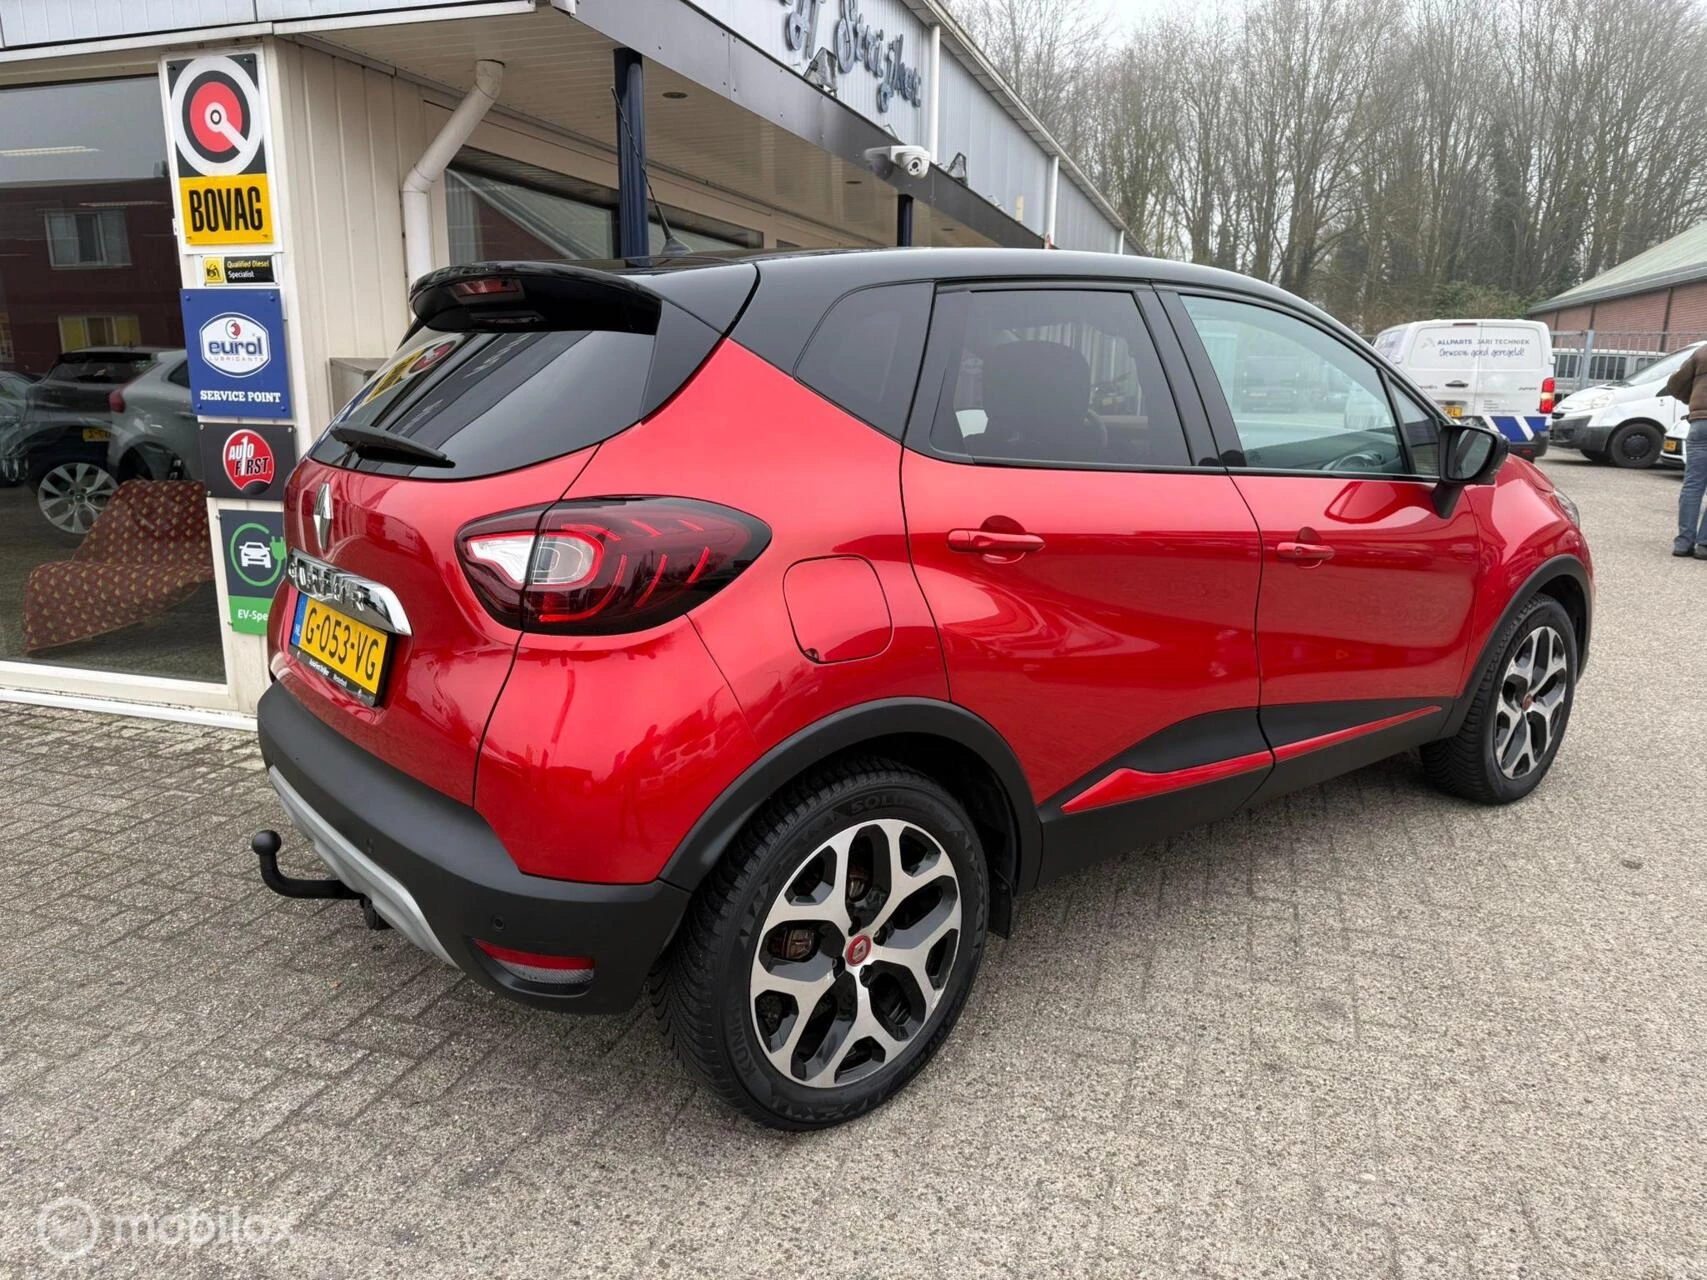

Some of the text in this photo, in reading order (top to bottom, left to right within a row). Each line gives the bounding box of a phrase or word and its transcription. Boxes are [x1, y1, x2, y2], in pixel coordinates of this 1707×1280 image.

[188, 186, 264, 232] BOVAG
[226, 259, 270, 269] Qualified Diesel
[209, 336, 263, 356] eurol
[200, 389, 281, 403] SERVICE POINT
[305, 607, 379, 681] G-053-VG
